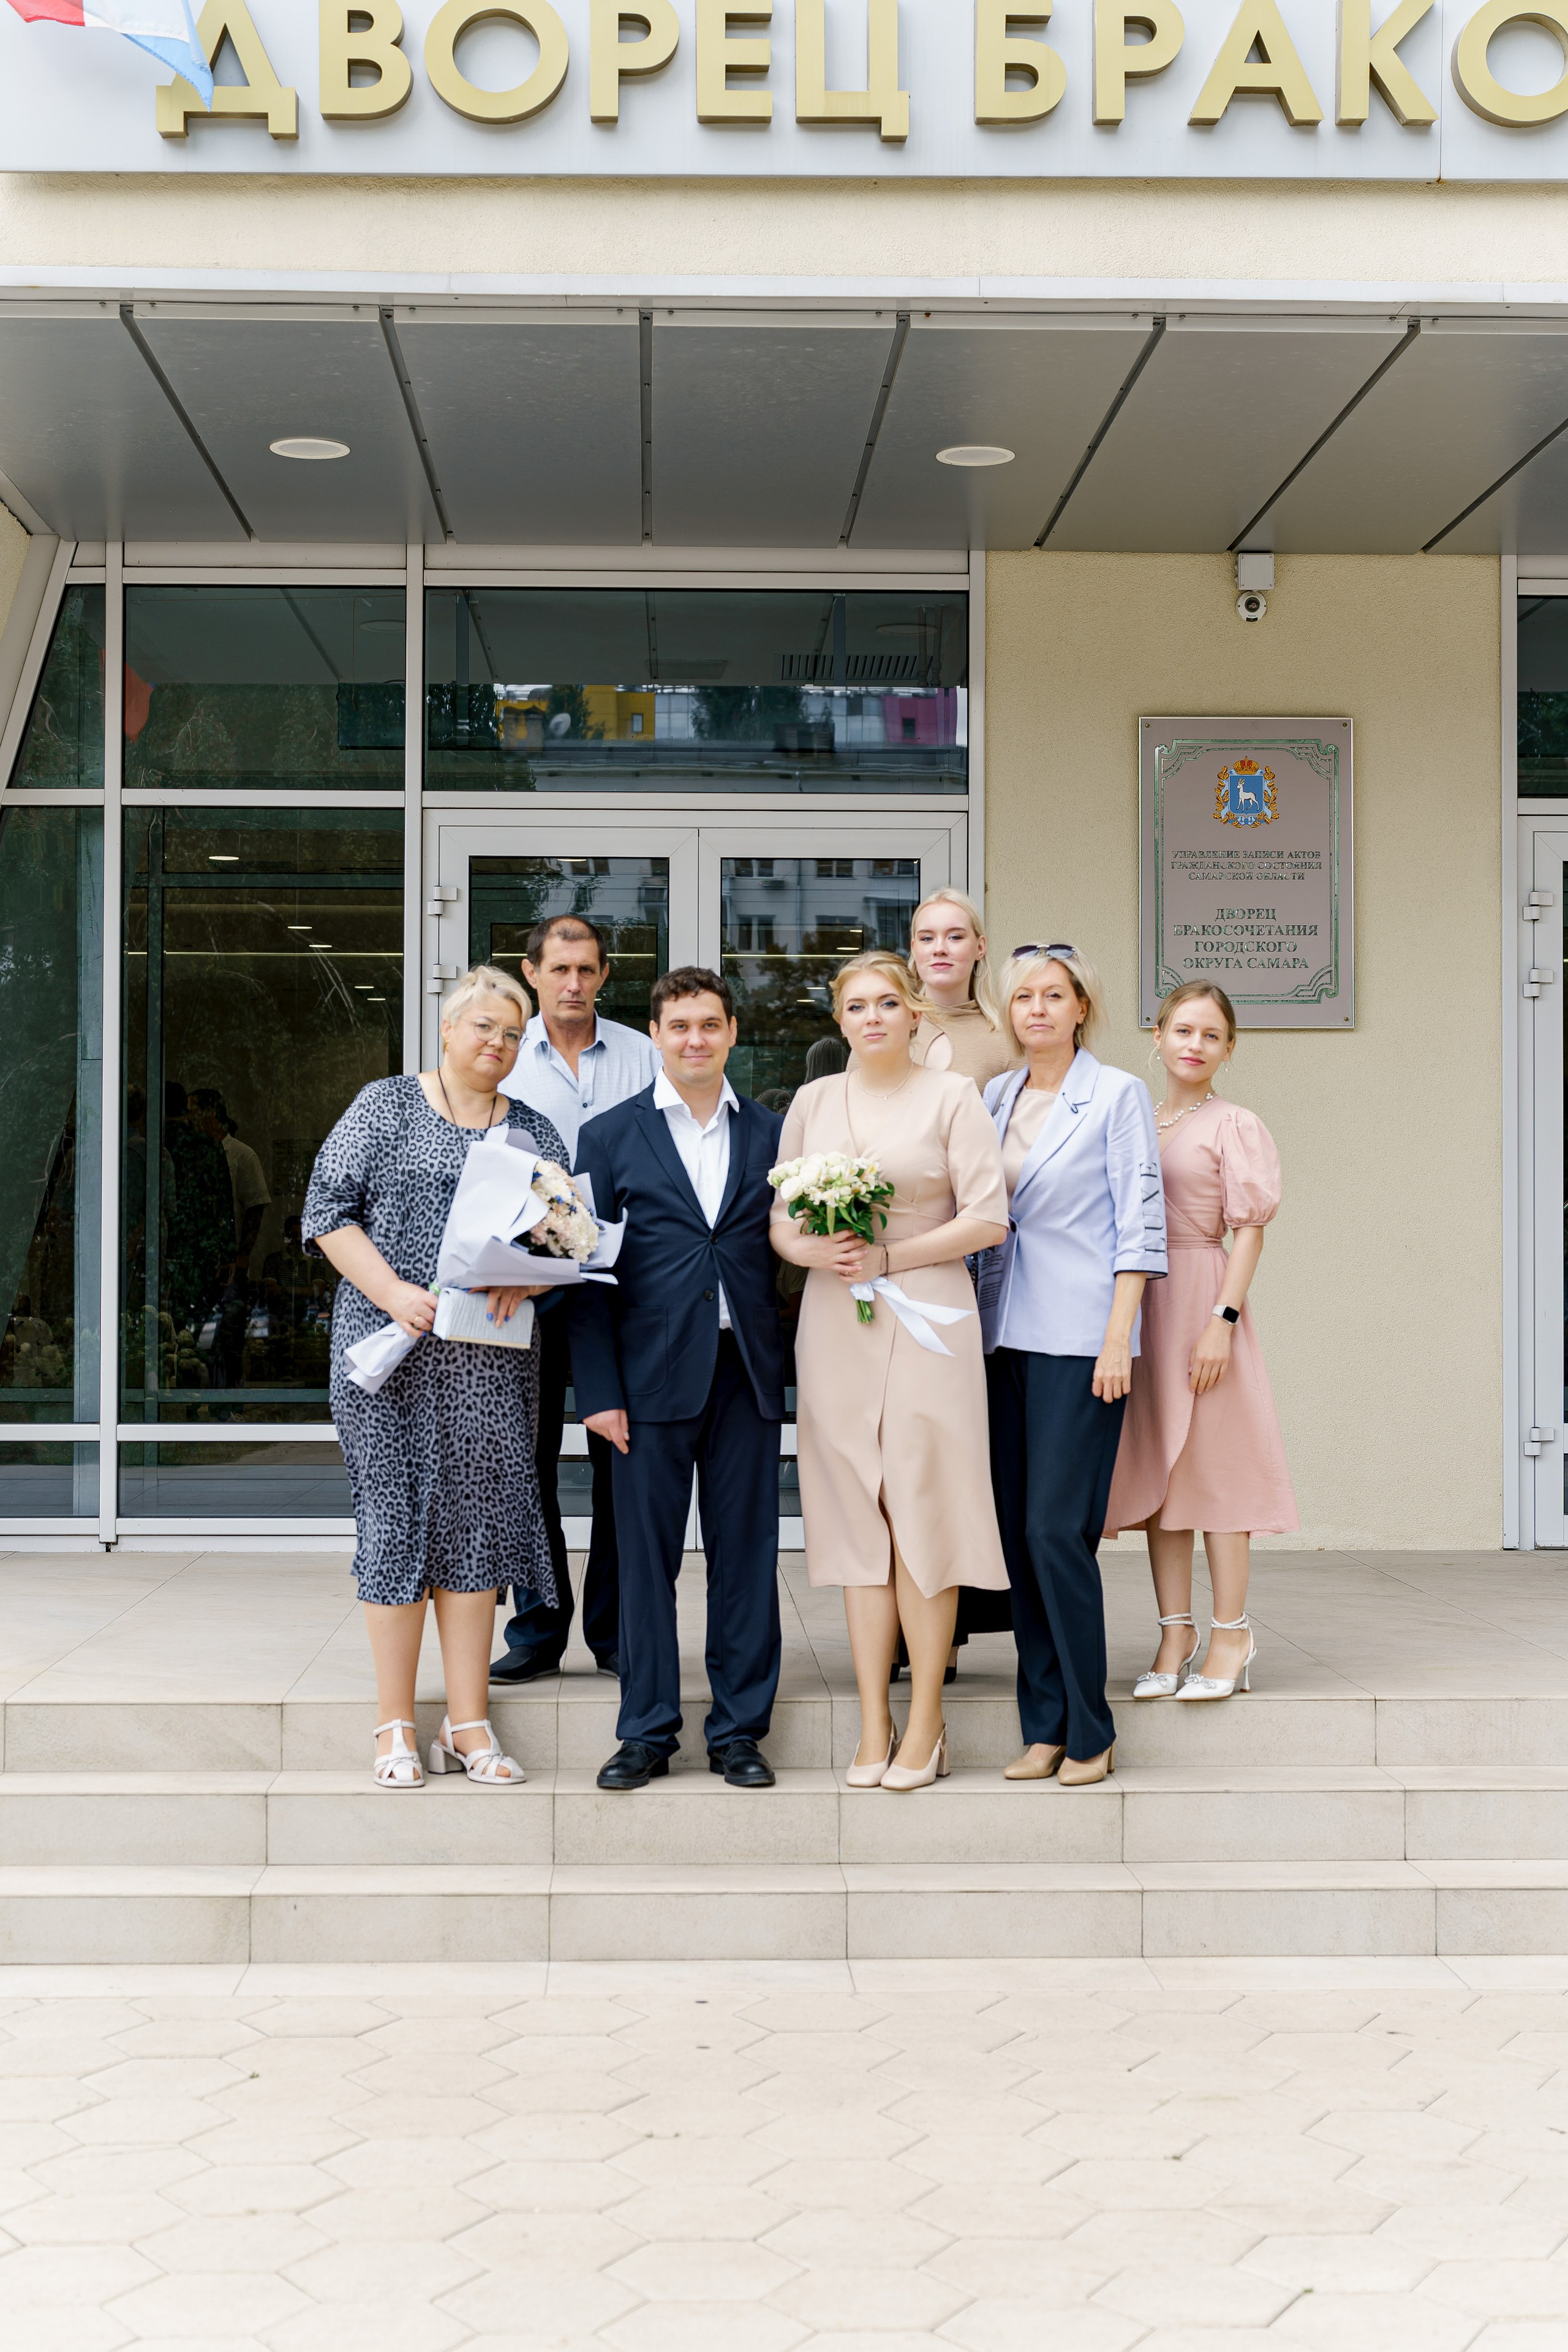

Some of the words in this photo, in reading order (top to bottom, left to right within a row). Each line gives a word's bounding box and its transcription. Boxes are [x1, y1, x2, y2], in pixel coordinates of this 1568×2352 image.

[155, 0, 909, 142] ДВОРЕЦ
[1172, 850, 1240, 859] УПРАВЛЕНИЕ
[1242, 850, 1284, 859] ЗАПИСИ
[1287, 850, 1321, 859] АКТОВ
[1170, 861, 1255, 870] ГРАЖДАНСКОГО
[1257, 861, 1322, 870] СОСТОЯНИЯ
[1188, 871, 1253, 880] САМАРСКОЙ
[1215, 908, 1276, 922] ДВОРЕЦ
[1173, 924, 1318, 937] БРАКОСОЧЕТАНИЯ
[1194, 941, 1297, 955] ГОРОДСКОГО
[1182, 957, 1243, 969] ОКРУГА
[1246, 957, 1309, 969] САМАРА
[1140, 1162, 1166, 1253] LUXE
